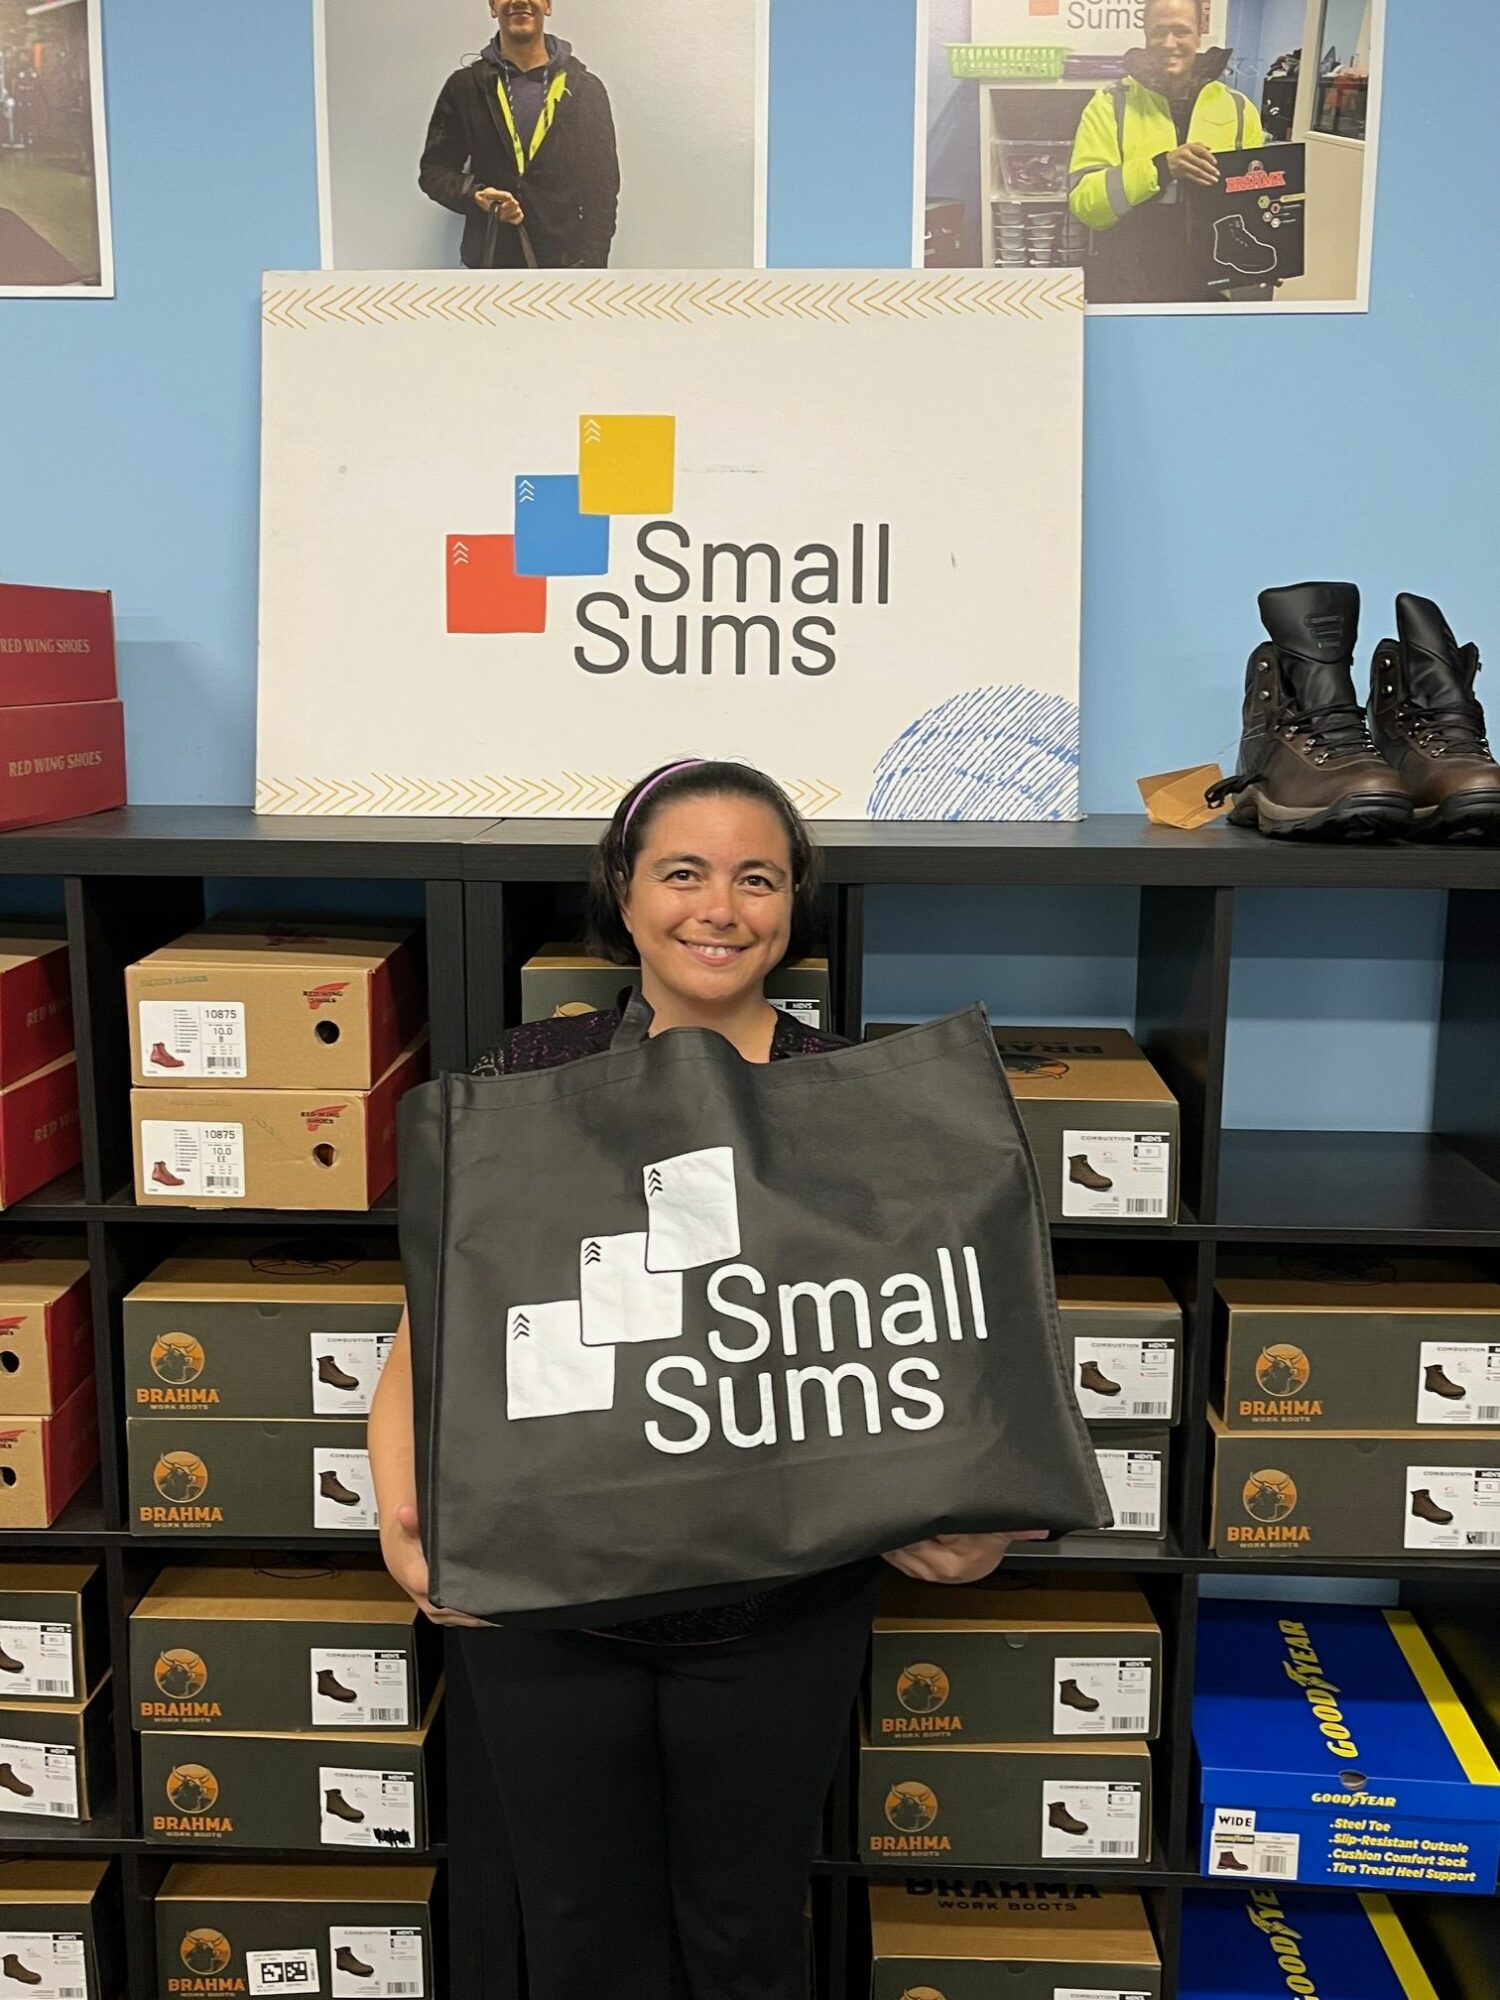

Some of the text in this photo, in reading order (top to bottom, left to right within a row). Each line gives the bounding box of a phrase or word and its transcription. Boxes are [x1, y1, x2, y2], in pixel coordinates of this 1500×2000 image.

[634, 521, 890, 603] Small
[574, 591, 837, 676] Sums
[0, 639, 91, 653] RED WING SHOES
[9, 751, 103, 777] RED WING SHOES
[205, 1009, 237, 1020] 10875
[213, 1027, 233, 1036] 10.0
[204, 1130, 236, 1140] 10875
[212, 1147, 232, 1156] 10.0
[707, 1246, 988, 1362] Small
[136, 1388, 220, 1403] BRAHMA
[644, 1354, 945, 1454] Sums
[1240, 1400, 1323, 1416] BRAHMA
[139, 1506, 223, 1521] BRAHMA
[1227, 1526, 1311, 1541] BRAHMA
[1278, 1619, 1359, 1758] GOODYEAR
[140, 1702, 222, 1717] BRAHMA
[881, 1716, 963, 1732] BRAHMA
[1311, 1792, 1397, 1807] GOODYEAR
[153, 1816, 233, 1831] BRAHMA
[1218, 1815, 1253, 1827] WIDE
[1334, 1818, 1391, 1832] Steel Toe
[870, 1835, 952, 1850] BRAHMA
[1334, 1833, 1469, 1853] Slip-Resistant Outsole
[1332, 1848, 1469, 1868] Cushion Comfort Sock
[1332, 1862, 1477, 1882] Tire Tread Heel Support
[906, 1878, 1103, 1899] BRAHMA
[938, 1901, 1078, 1911] WORK BOOTS
[168, 1978, 246, 1992] BRAHMA
